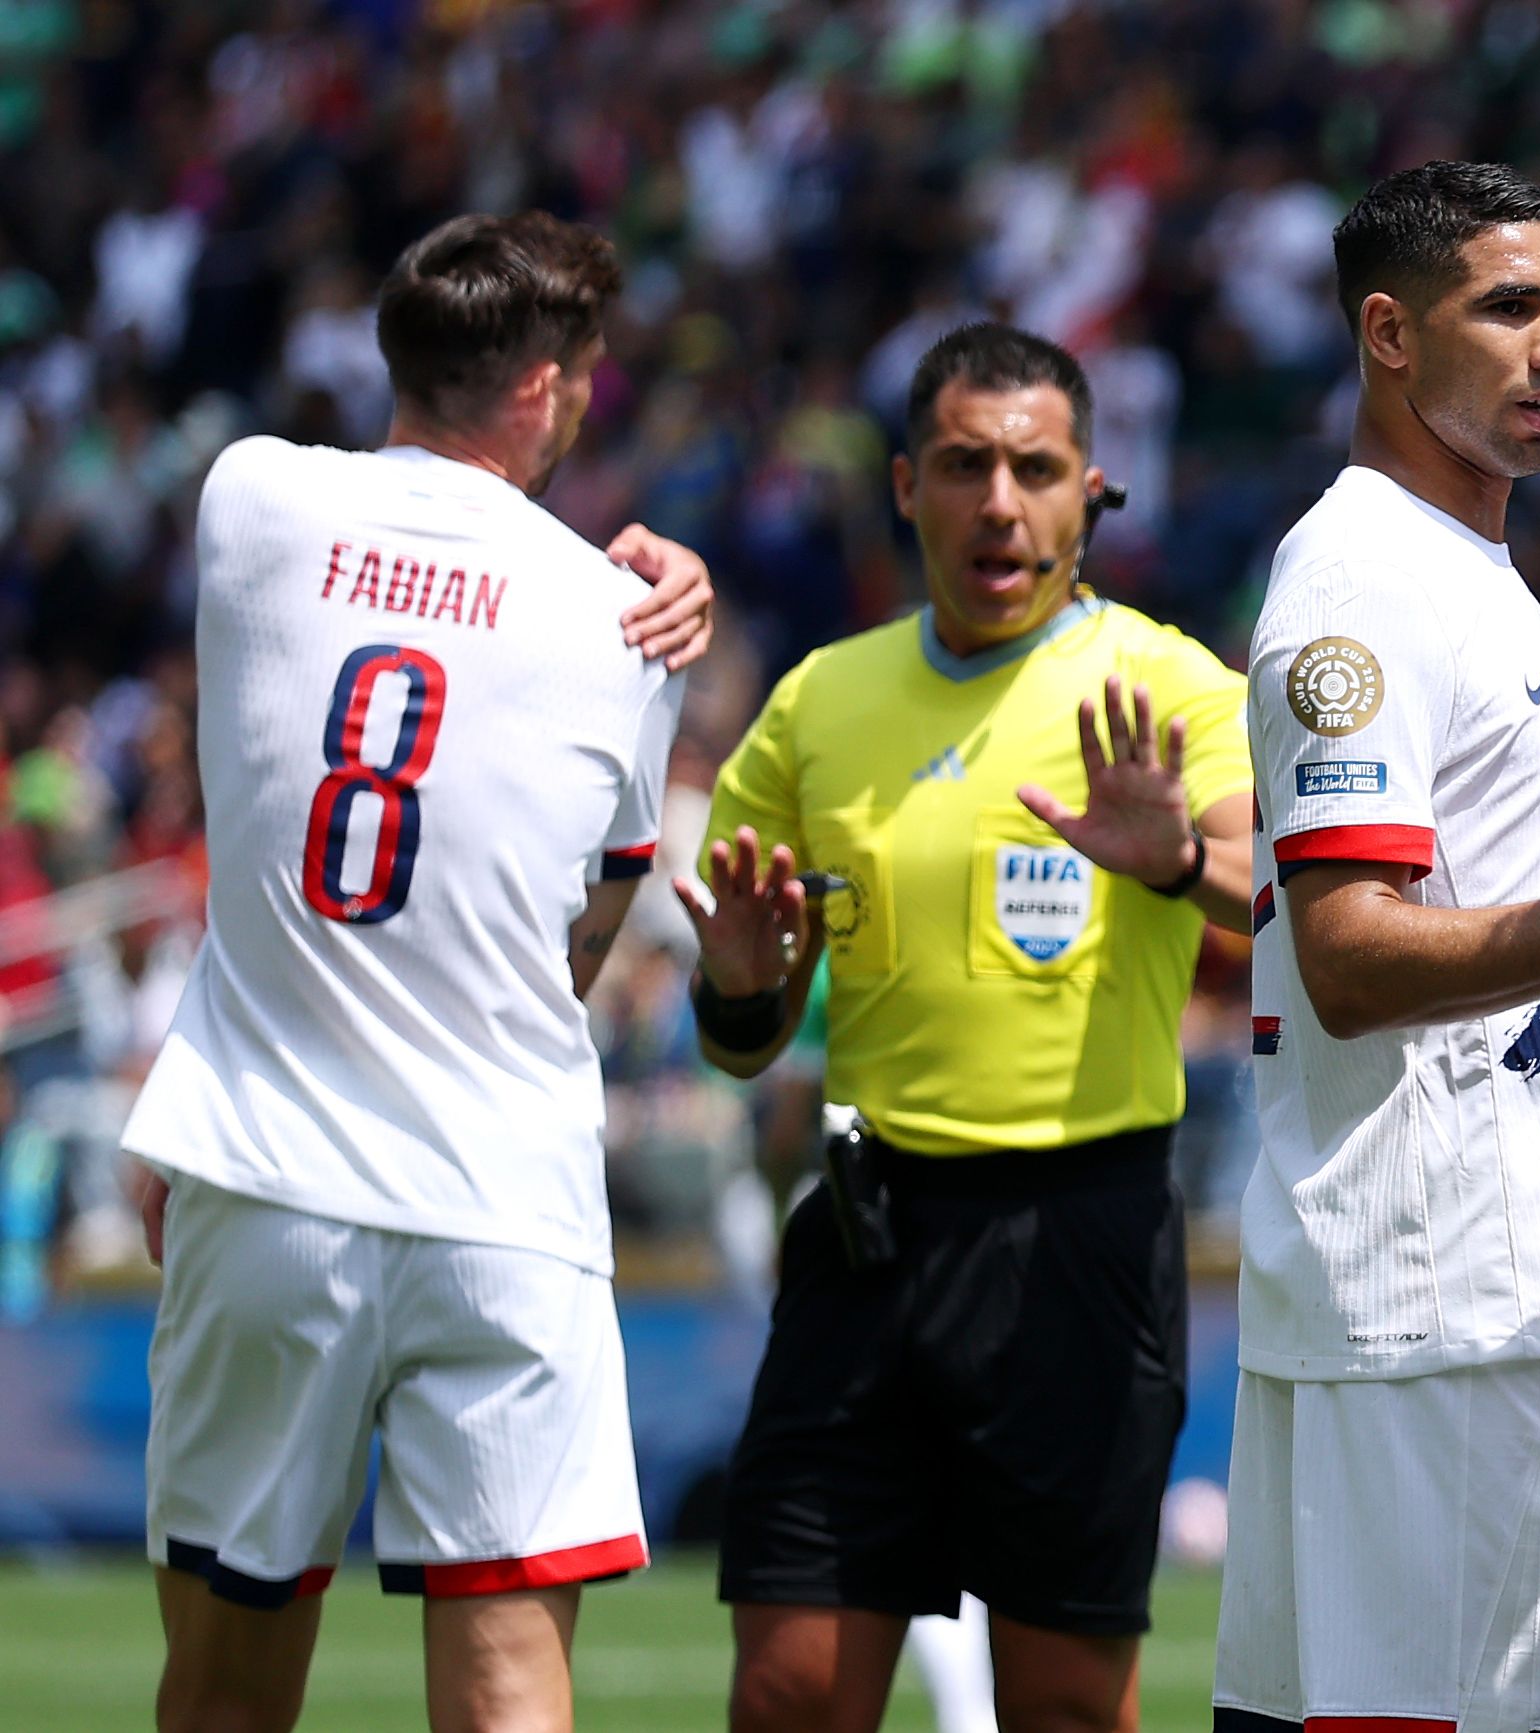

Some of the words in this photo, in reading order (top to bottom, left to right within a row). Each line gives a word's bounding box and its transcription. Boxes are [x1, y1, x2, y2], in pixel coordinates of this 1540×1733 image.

[320, 540, 510, 630] FABIAN
[1296, 646, 1337, 678] WORLD
[1340, 647, 1366, 665] CUP
[1362, 667, 1375, 684] 25
[1295, 682, 1313, 714] CLUB
[1357, 687, 1376, 712] USA
[1316, 713, 1355, 728] FIFA
[1304, 763, 1345, 777] FOOTBALL
[1346, 763, 1378, 776] UNITES
[302, 644, 448, 926] 8
[1304, 778, 1320, 792] the
[1320, 775, 1352, 791] World
[1355, 780, 1375, 788] FIFA
[1006, 854, 1081, 881] FIFA
